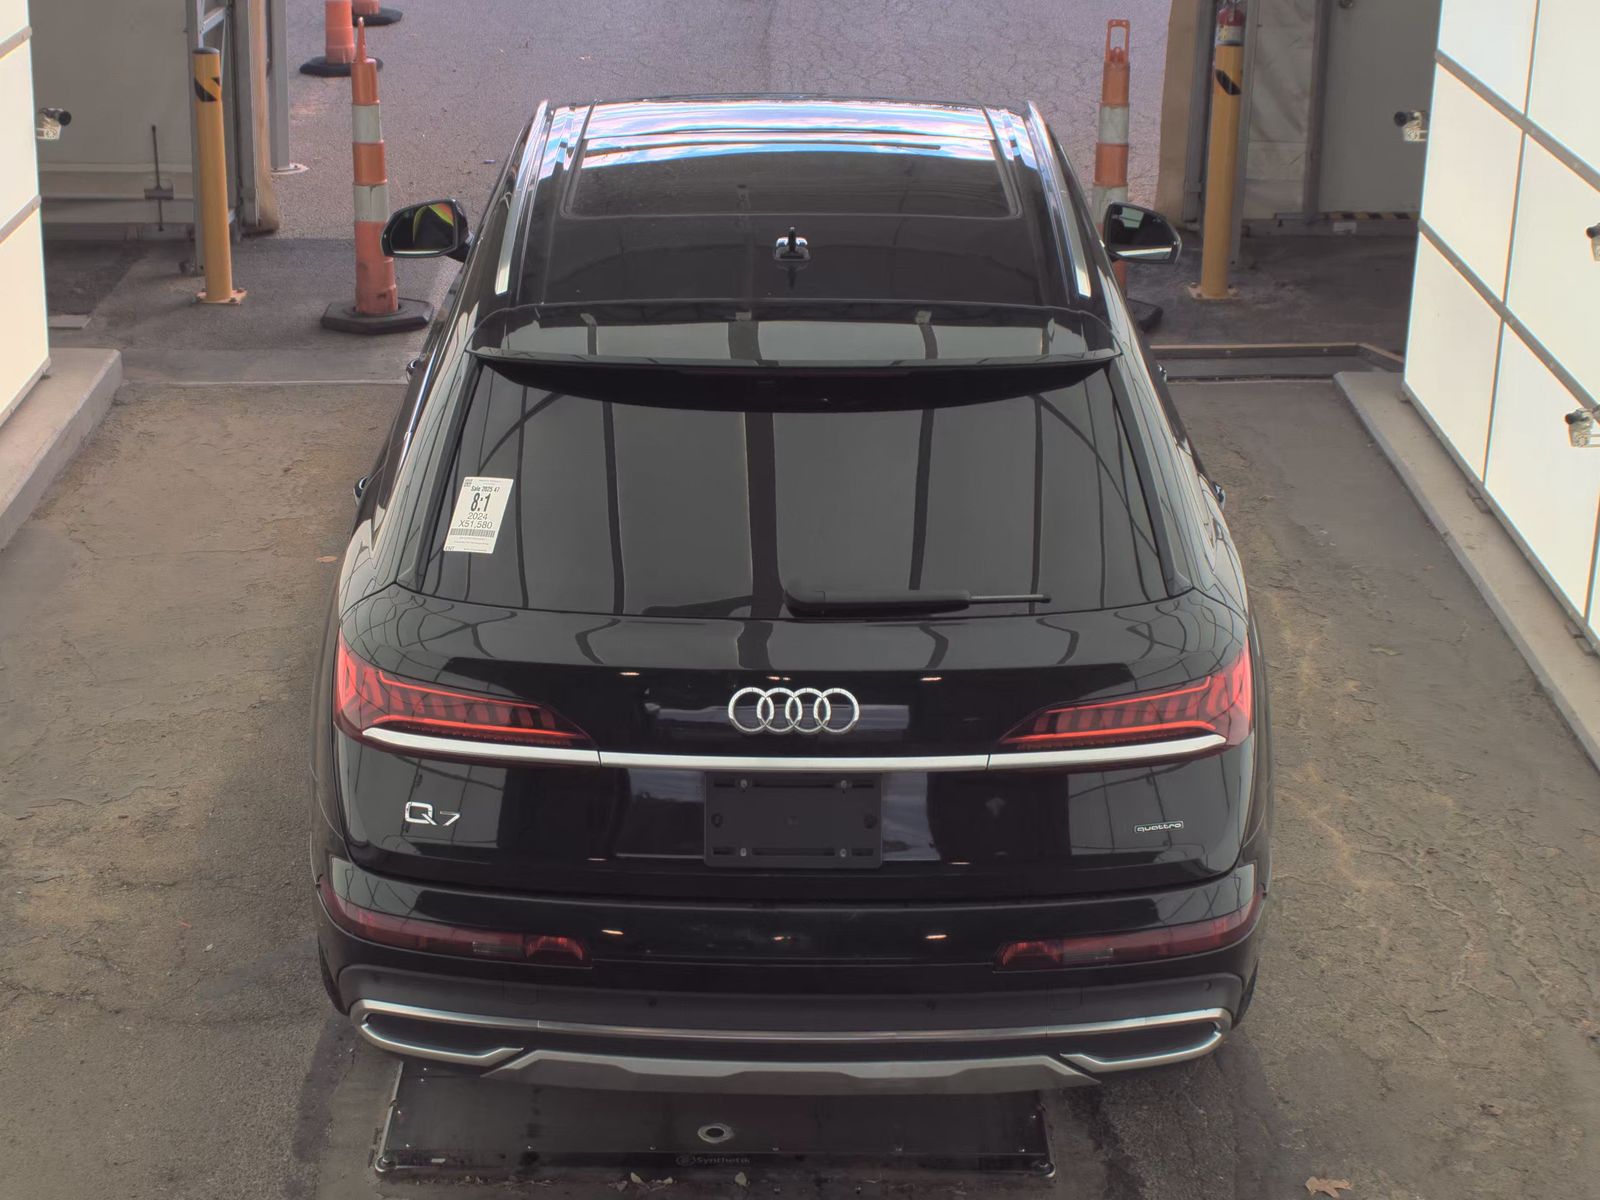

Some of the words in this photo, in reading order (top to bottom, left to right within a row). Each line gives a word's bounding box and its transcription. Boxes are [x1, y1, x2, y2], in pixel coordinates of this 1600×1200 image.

[467, 512, 488, 520] 2024
[458, 520, 493, 529] X51,580
[404, 801, 461, 826] Q7
[1136, 823, 1182, 833] quattro
